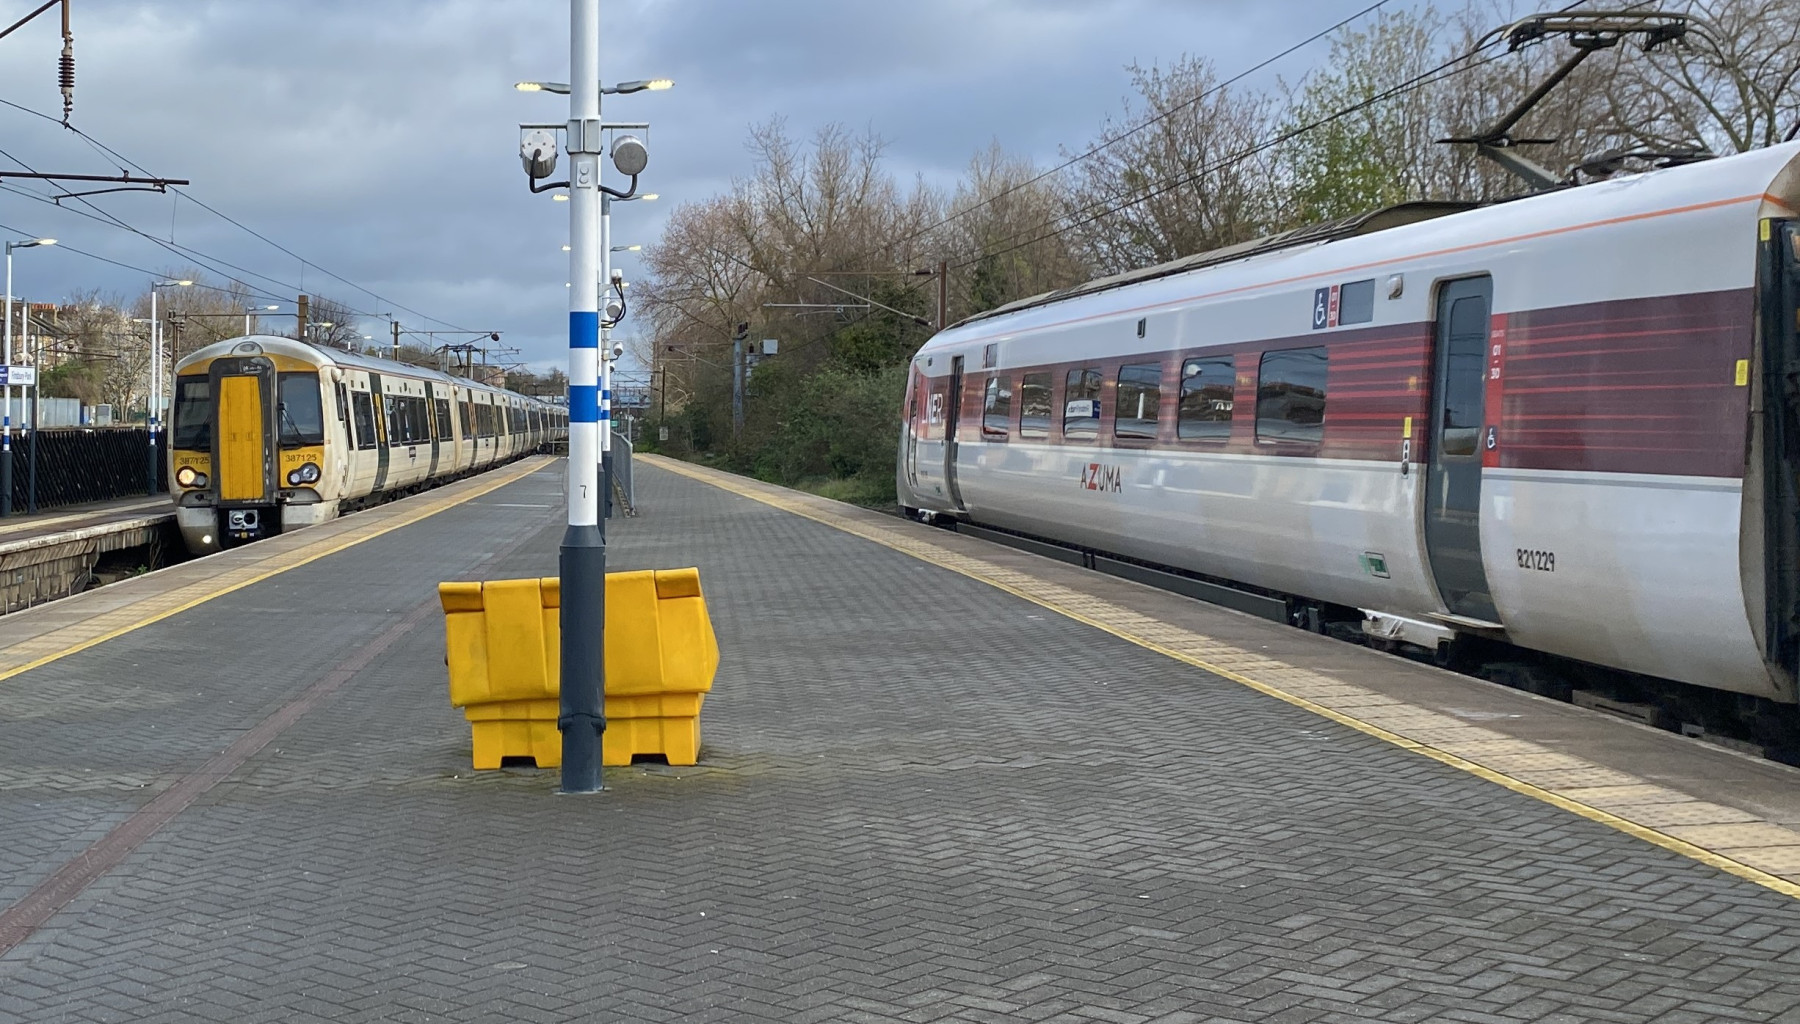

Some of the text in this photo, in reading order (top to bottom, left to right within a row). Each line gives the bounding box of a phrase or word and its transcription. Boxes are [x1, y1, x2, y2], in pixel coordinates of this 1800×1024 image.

[1492, 344, 1501, 356] 01
[1490, 367, 1500, 380] 30
[179, 456, 210, 465] 387125
[285, 453, 317, 462] 387125
[1080, 462, 1122, 493] AZUMA
[579, 484, 587, 499] 7
[1516, 548, 1555, 572] 821229
